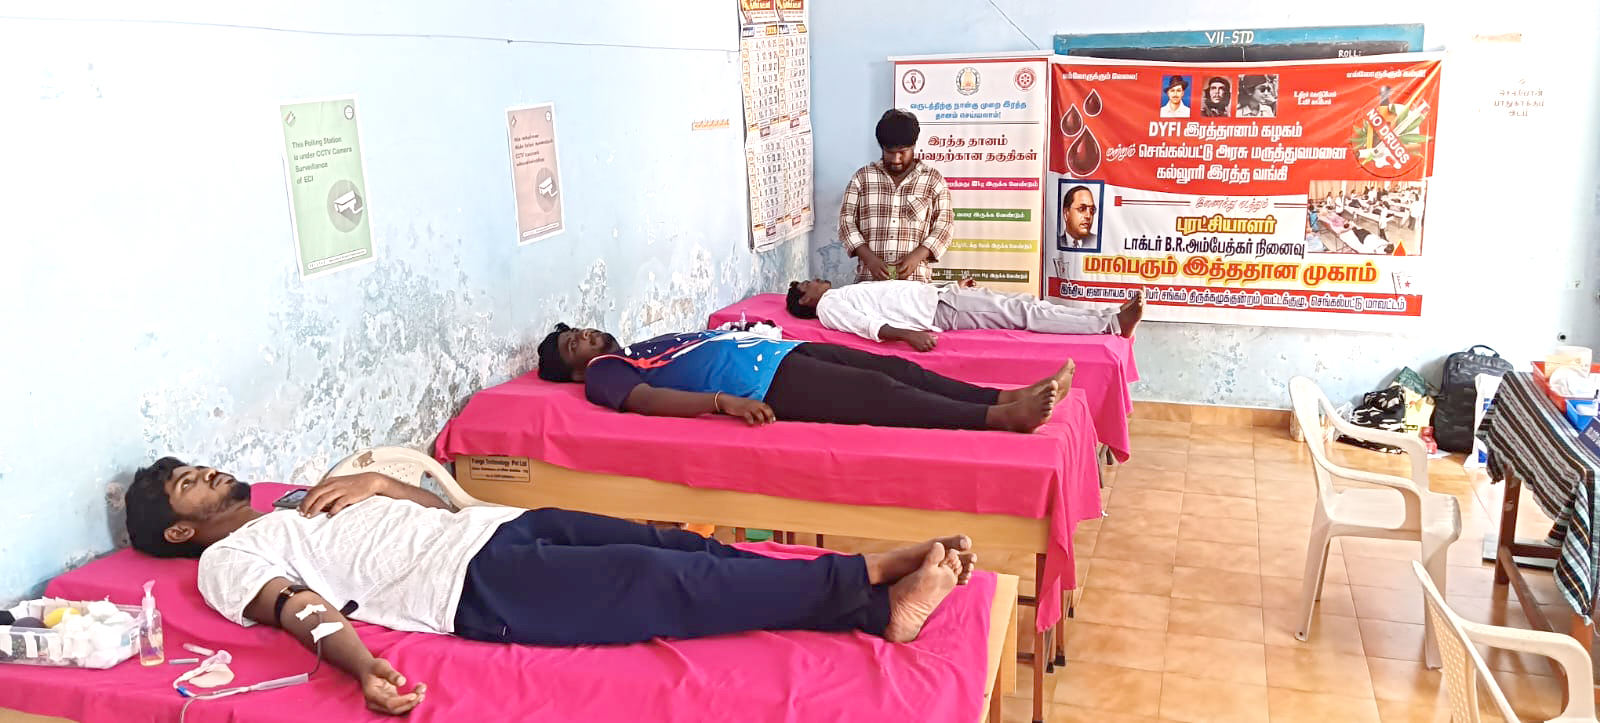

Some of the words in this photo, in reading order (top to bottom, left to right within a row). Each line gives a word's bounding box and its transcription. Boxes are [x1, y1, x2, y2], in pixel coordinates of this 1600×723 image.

[1205, 30, 1254, 44] VII-STD
[928, 134, 965, 148] இரத்த
[968, 134, 1008, 148] தானம்
[1148, 121, 1181, 137] DYFI
[1261, 121, 1303, 142] கழகம்
[1366, 108, 1383, 127] NO
[1379, 125, 1410, 164] DRUGS
[299, 152, 315, 160] under
[316, 149, 331, 157] CCTV
[985, 149, 1038, 162] தகுதிகள்
[1138, 142, 1214, 162] செங்கல்பட்டு
[1216, 144, 1249, 160] அரசு
[1251, 143, 1348, 164] மருத்துவமனை
[1157, 163, 1206, 184] கல்லூரி
[1207, 164, 1251, 184] இரத்த
[1253, 164, 1289, 181] வங்கி
[1176, 213, 1277, 236] புரட்சியாளர்
[1124, 235, 1163, 252] டாக்டர்
[1255, 239, 1305, 260] நினைவு
[1084, 254, 1179, 279] மாபெரும்
[1302, 261, 1378, 286] முகாம்
